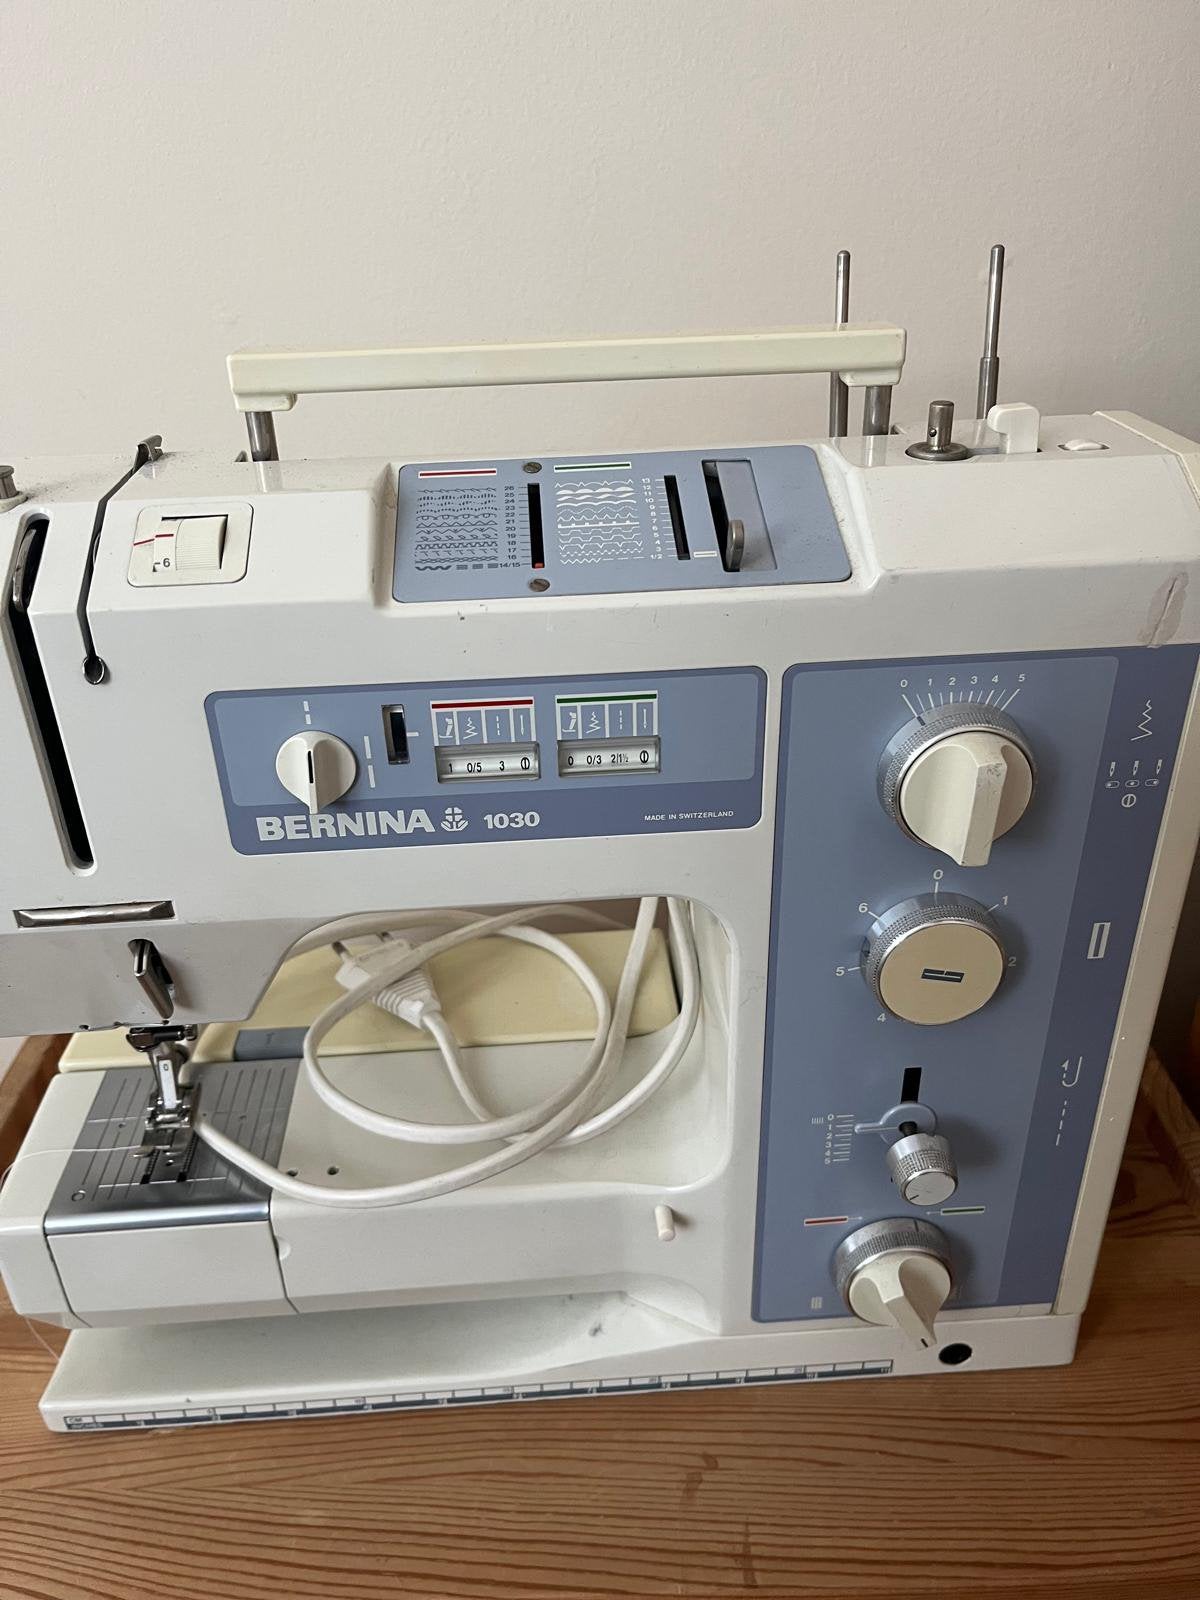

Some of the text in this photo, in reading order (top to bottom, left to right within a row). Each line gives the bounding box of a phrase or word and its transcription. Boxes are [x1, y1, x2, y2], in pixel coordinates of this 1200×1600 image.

[163, 558, 170, 567] 6
[900, 674, 1026, 688] 0 1 2 3 4 5
[568, 756, 574, 766] 0
[586, 754, 602, 765] 0/3
[448, 760, 505, 773] 1 0/5 3
[483, 811, 540, 829] 1030
[679, 811, 734, 819] SWITZERLAND
[256, 809, 436, 841] BERNINA
[933, 869, 944, 880] 0
[1002, 895, 1008, 905] 1
[858, 903, 868, 913] 6
[1008, 956, 1016, 967] 2
[835, 966, 845, 977] 5
[877, 1013, 886, 1022] 4
